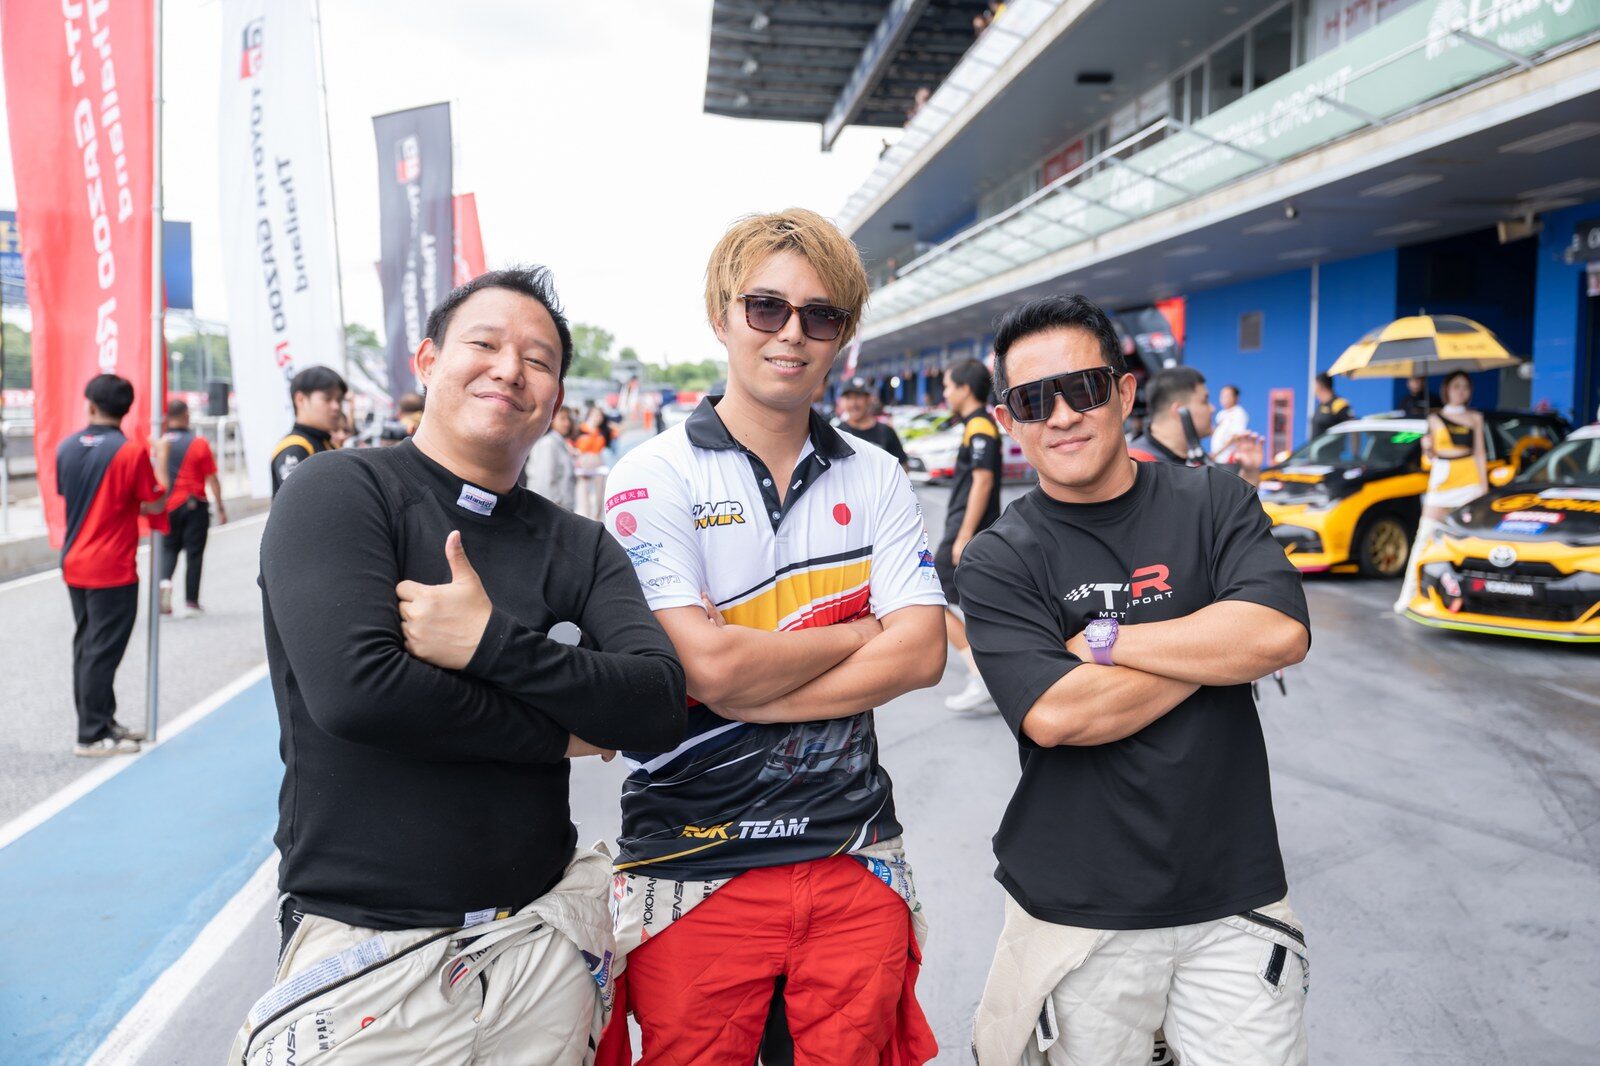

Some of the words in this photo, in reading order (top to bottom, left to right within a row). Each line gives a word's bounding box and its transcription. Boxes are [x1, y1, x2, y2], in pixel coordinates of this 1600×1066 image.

[738, 817, 810, 839] TEAM
[315, 1012, 329, 1050] MPACT
[326, 1011, 336, 1045] AKES
